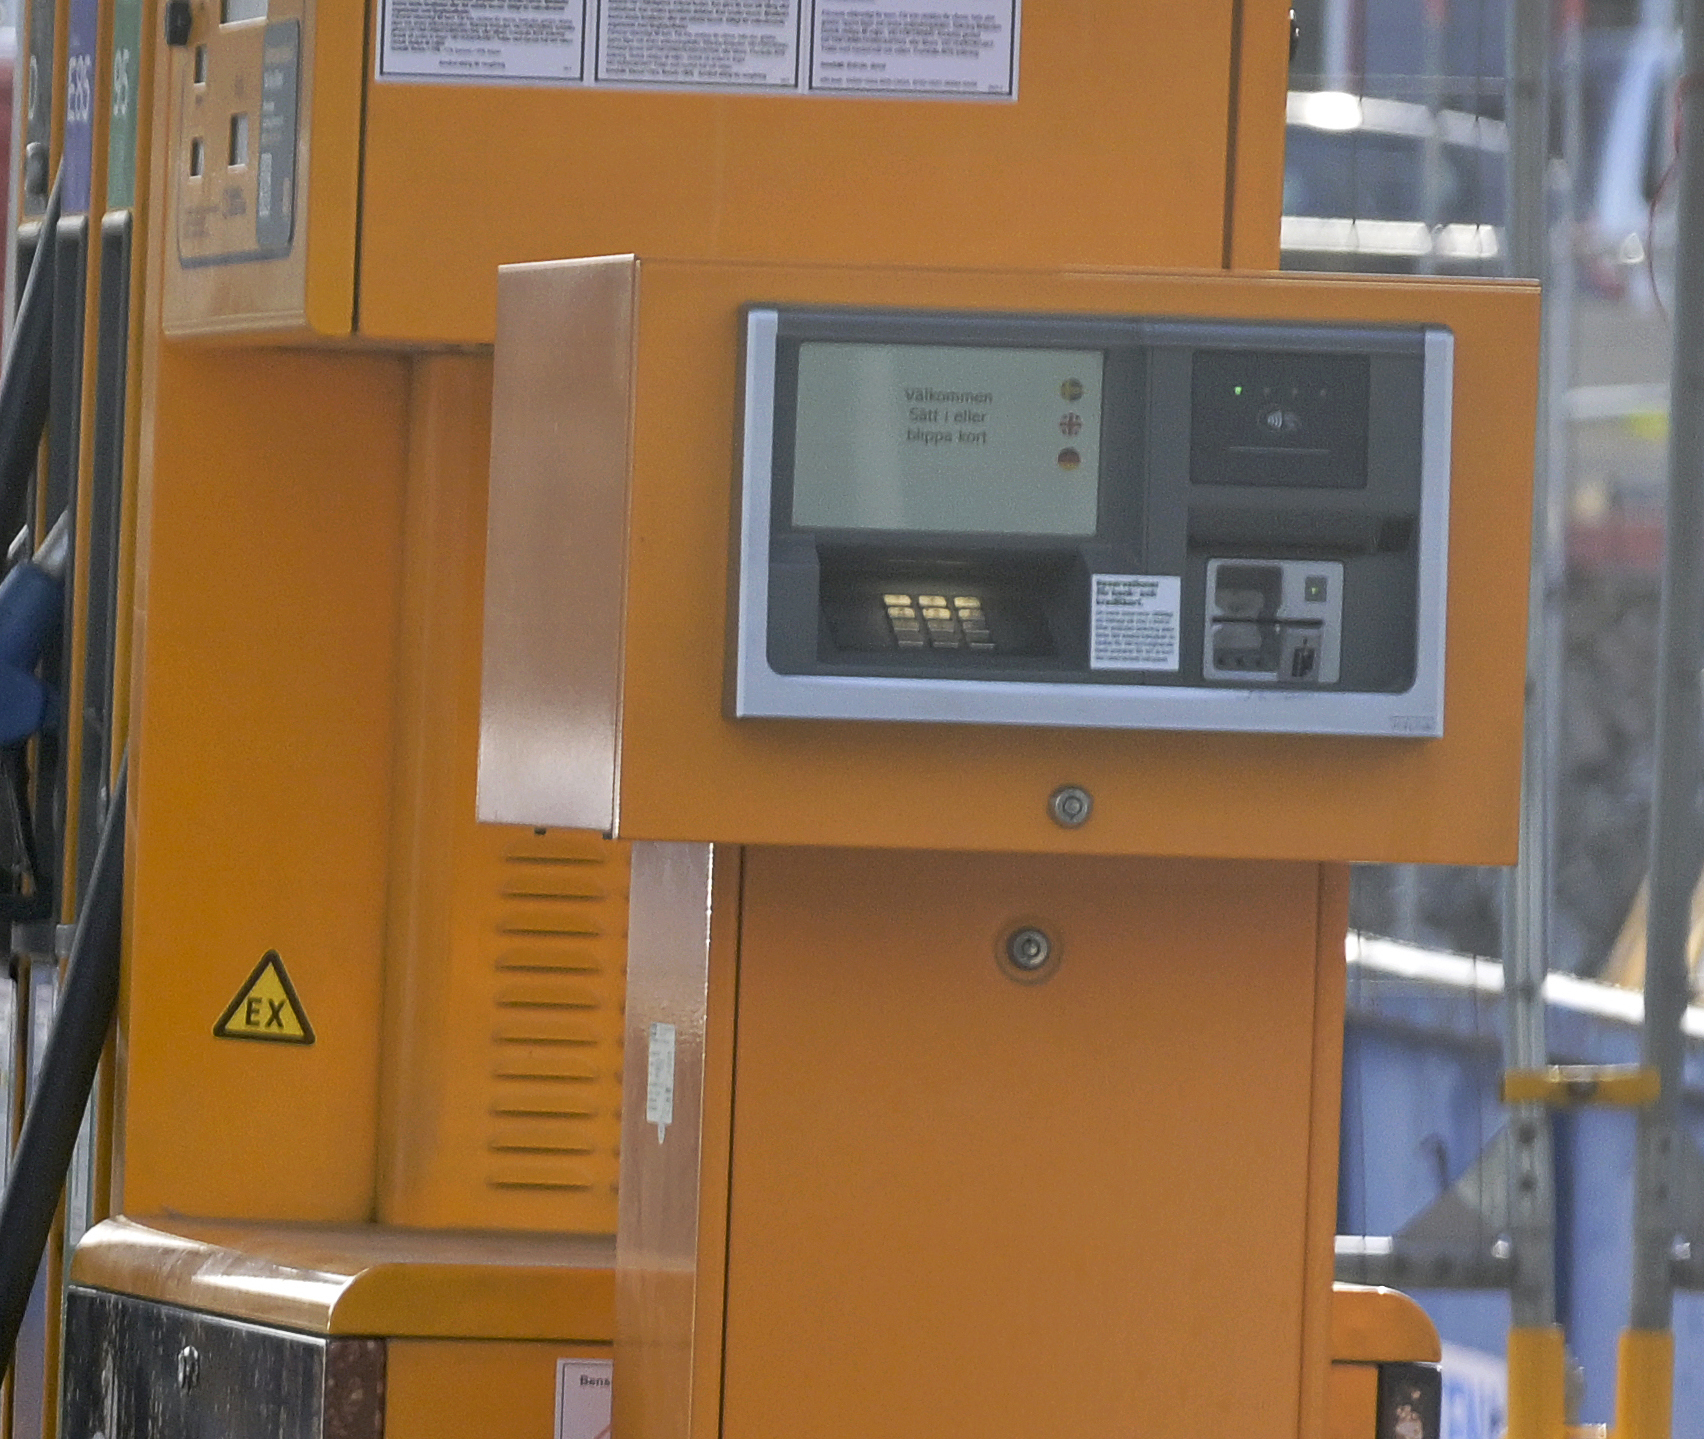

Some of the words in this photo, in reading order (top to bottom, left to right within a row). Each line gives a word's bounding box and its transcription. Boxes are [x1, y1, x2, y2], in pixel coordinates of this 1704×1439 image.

[67, 54, 91, 122] E85
[114, 48, 130, 116] 95
[953, 409, 987, 423] eller
[245, 997, 286, 1029] EX
